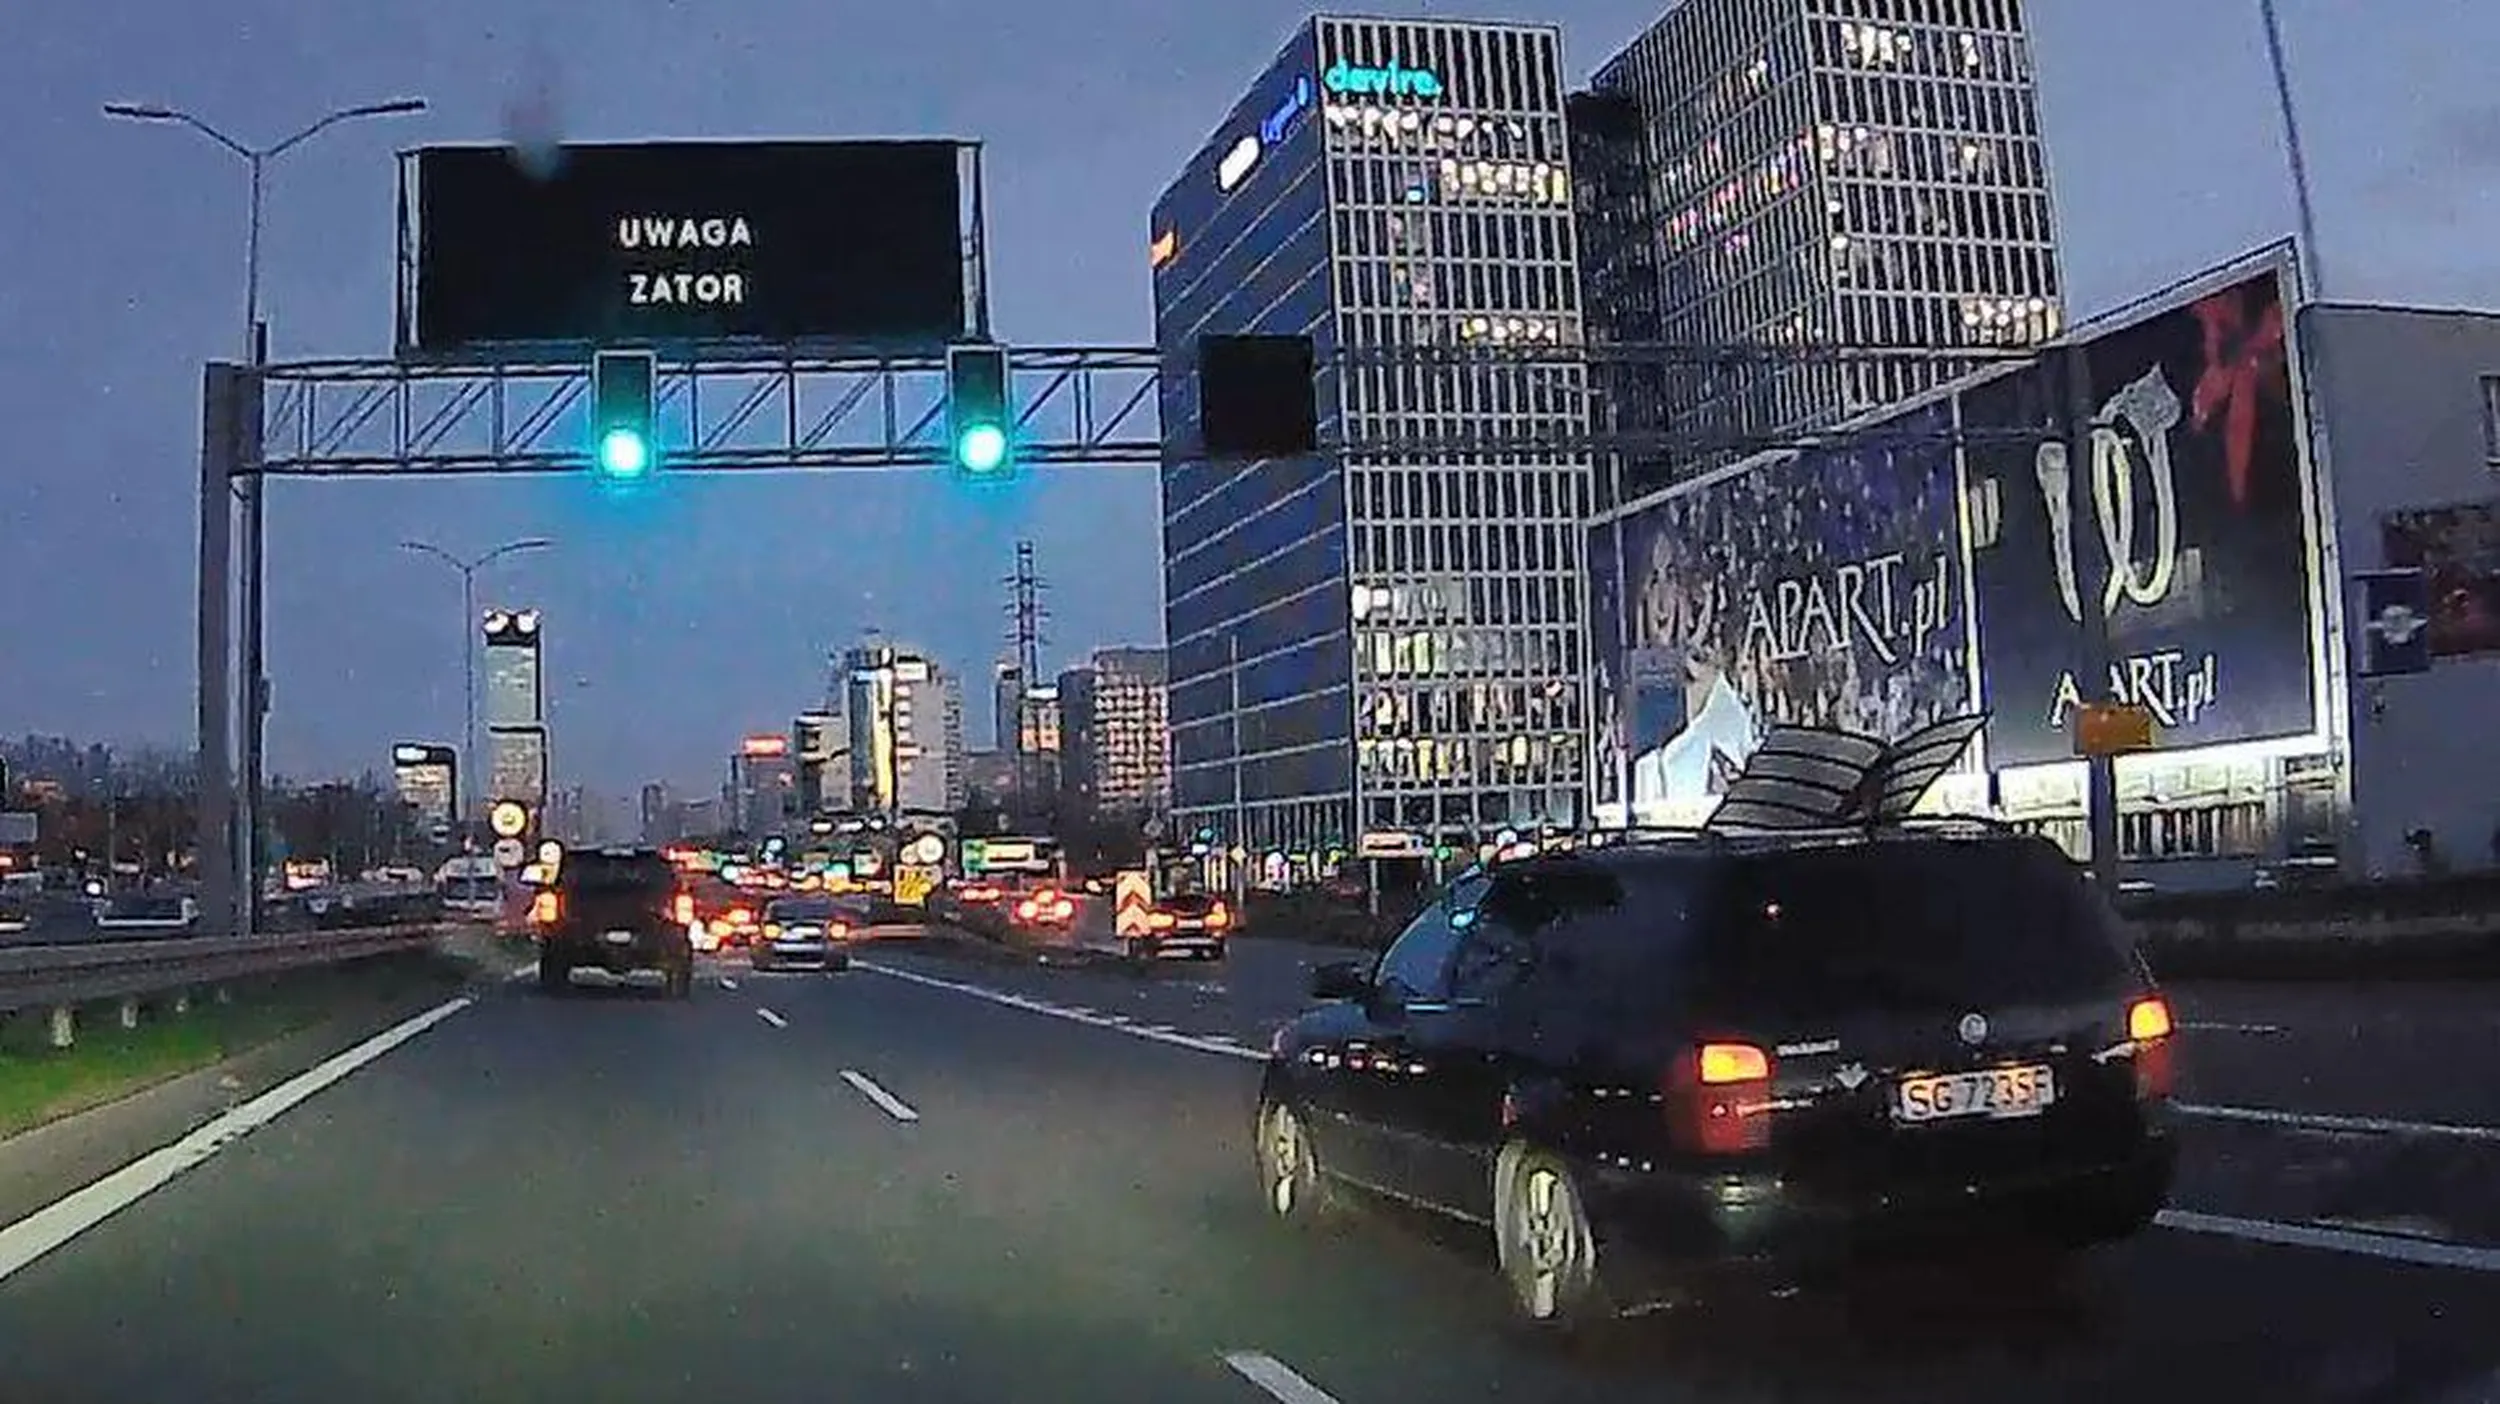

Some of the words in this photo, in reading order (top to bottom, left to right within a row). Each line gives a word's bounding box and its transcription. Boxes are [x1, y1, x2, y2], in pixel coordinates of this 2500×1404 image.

[619, 217, 751, 248] UWAGA
[629, 273, 743, 303] ZATOR
[1743, 552, 1947, 663] APART.pl
[2051, 653, 2215, 727] AART.pl
[1908, 1081, 1952, 1116] SG
